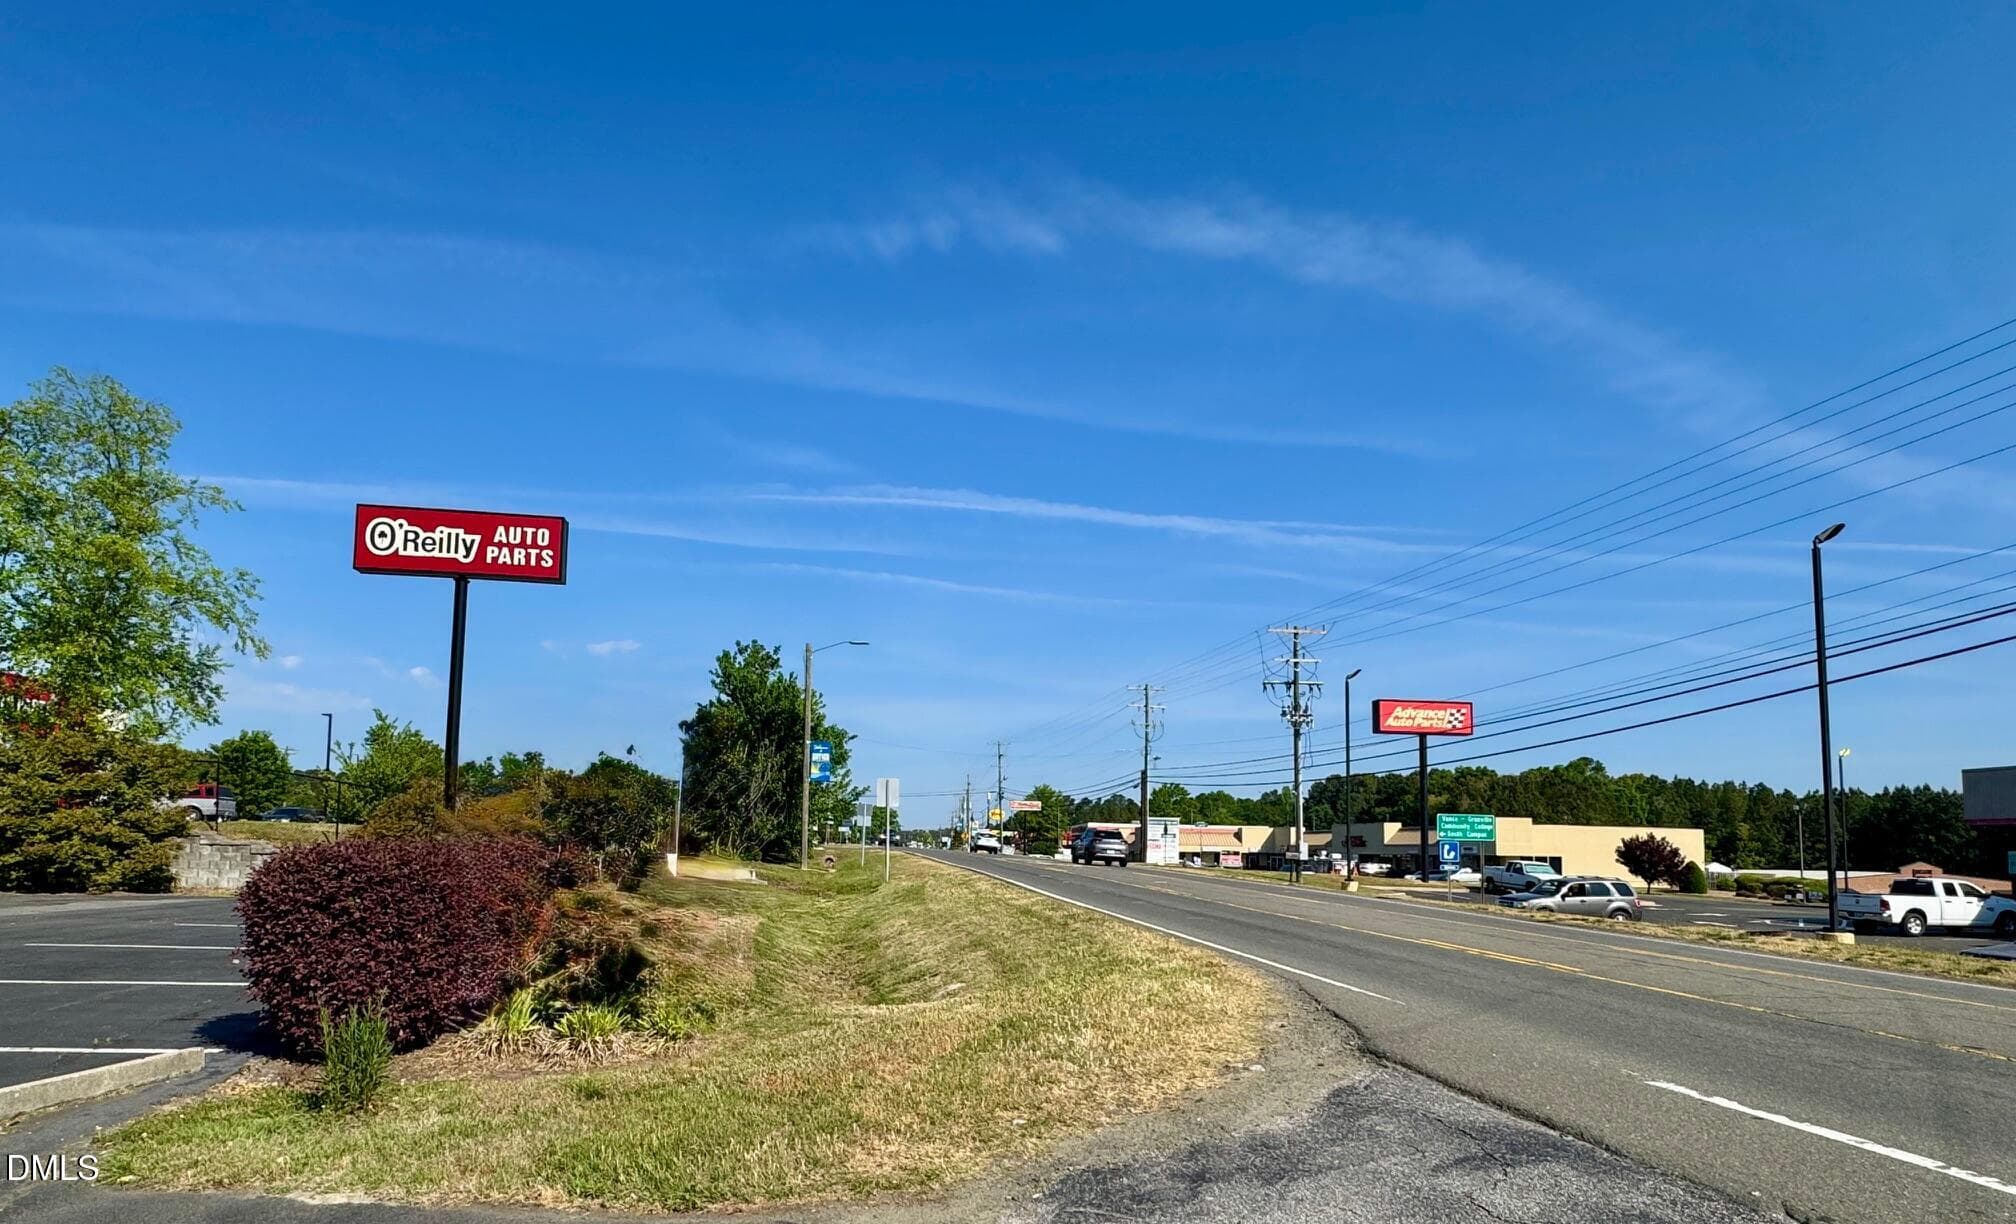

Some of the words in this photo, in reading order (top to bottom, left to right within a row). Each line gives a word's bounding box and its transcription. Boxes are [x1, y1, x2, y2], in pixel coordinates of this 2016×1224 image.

[367, 518, 480, 562] O'Reilly
[493, 525, 550, 547] AUTO
[485, 546, 554, 568] PARTS
[1384, 717, 1414, 727] Auto
[1413, 718, 1444, 728] Parts
[1392, 706, 1446, 719] Advance
